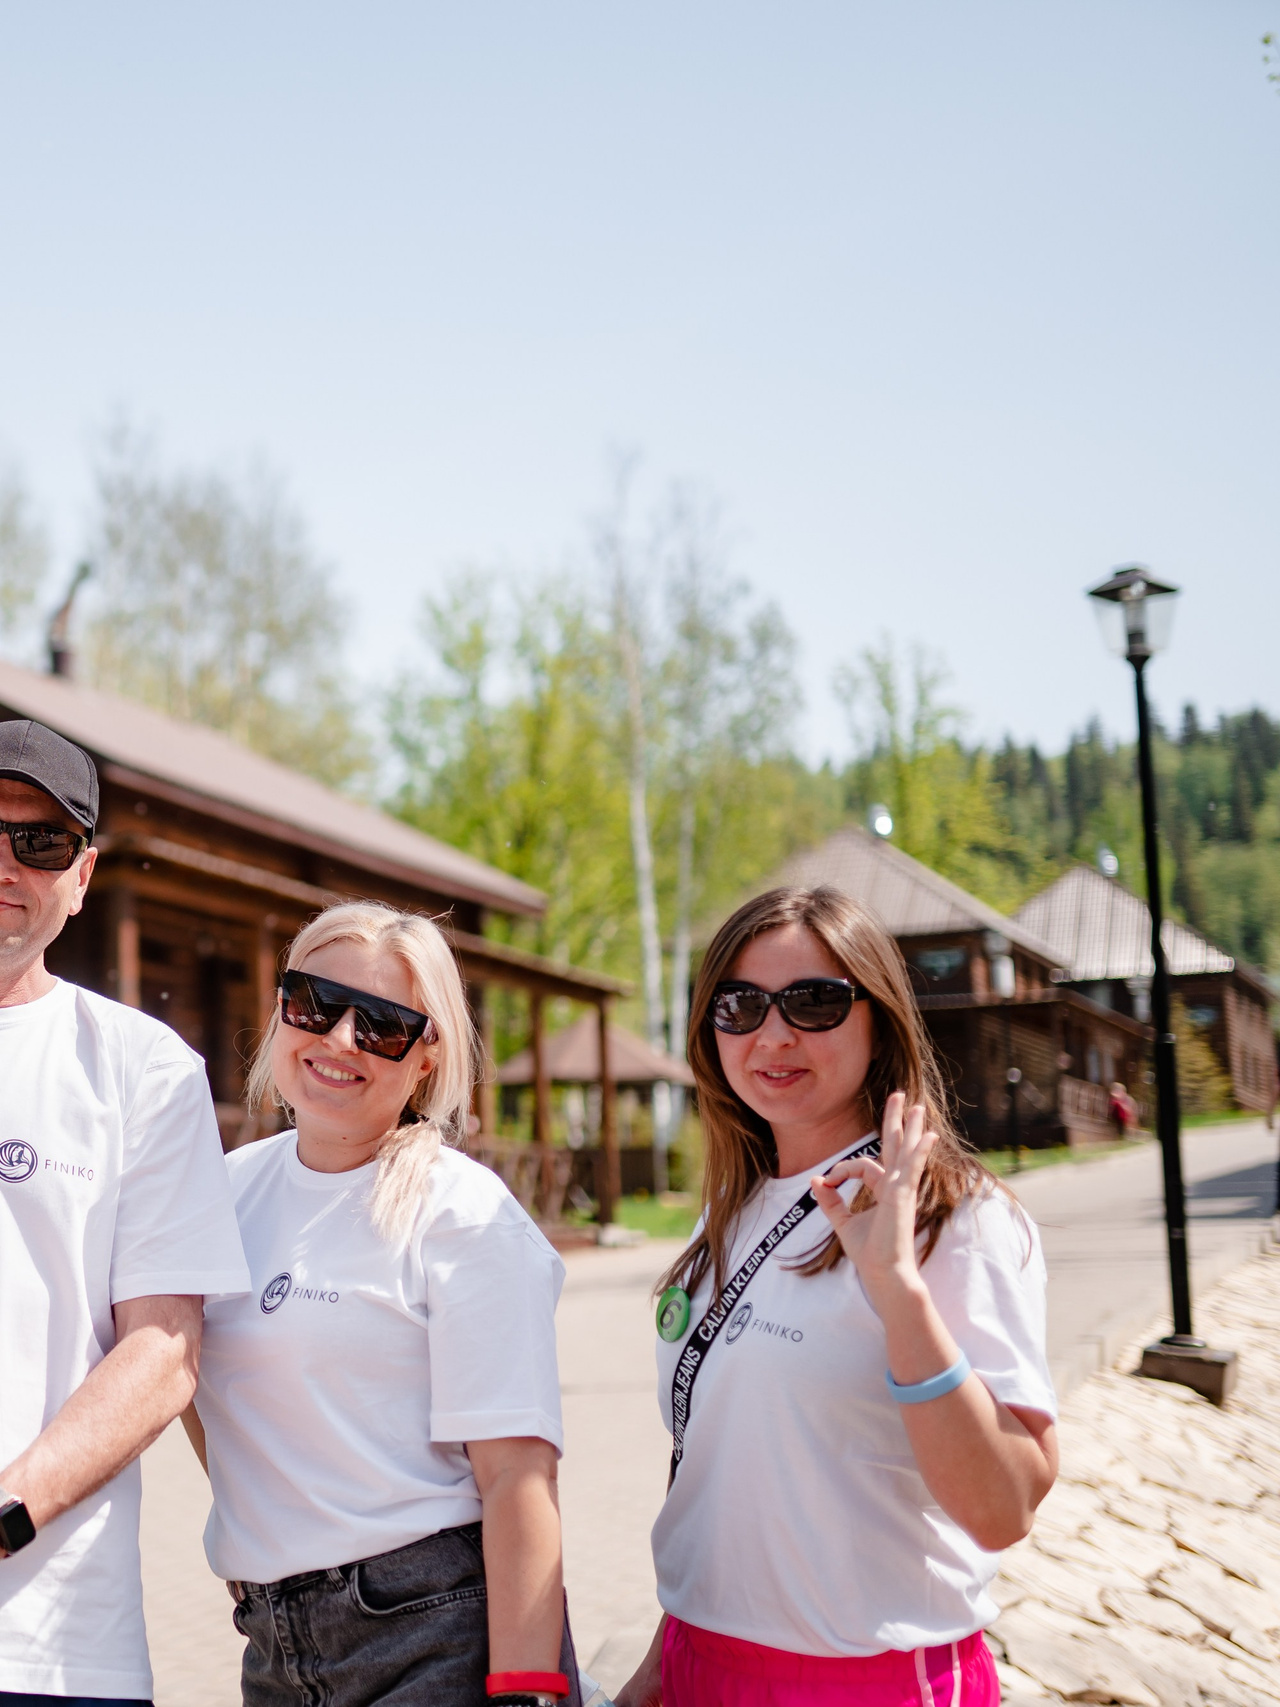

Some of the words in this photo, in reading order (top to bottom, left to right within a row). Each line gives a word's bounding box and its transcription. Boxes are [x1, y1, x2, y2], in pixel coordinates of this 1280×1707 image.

[44, 1158, 94, 1181] FINIKO
[698, 1286, 738, 1341] CALVIN
[731, 1247, 766, 1292] KLEIN
[764, 1205, 805, 1251] JEANS
[292, 1287, 340, 1303] FINIKO
[751, 1318, 804, 1343] FINIKO
[676, 1346, 701, 1393] JEANS
[673, 1387, 687, 1425] KLEIN
